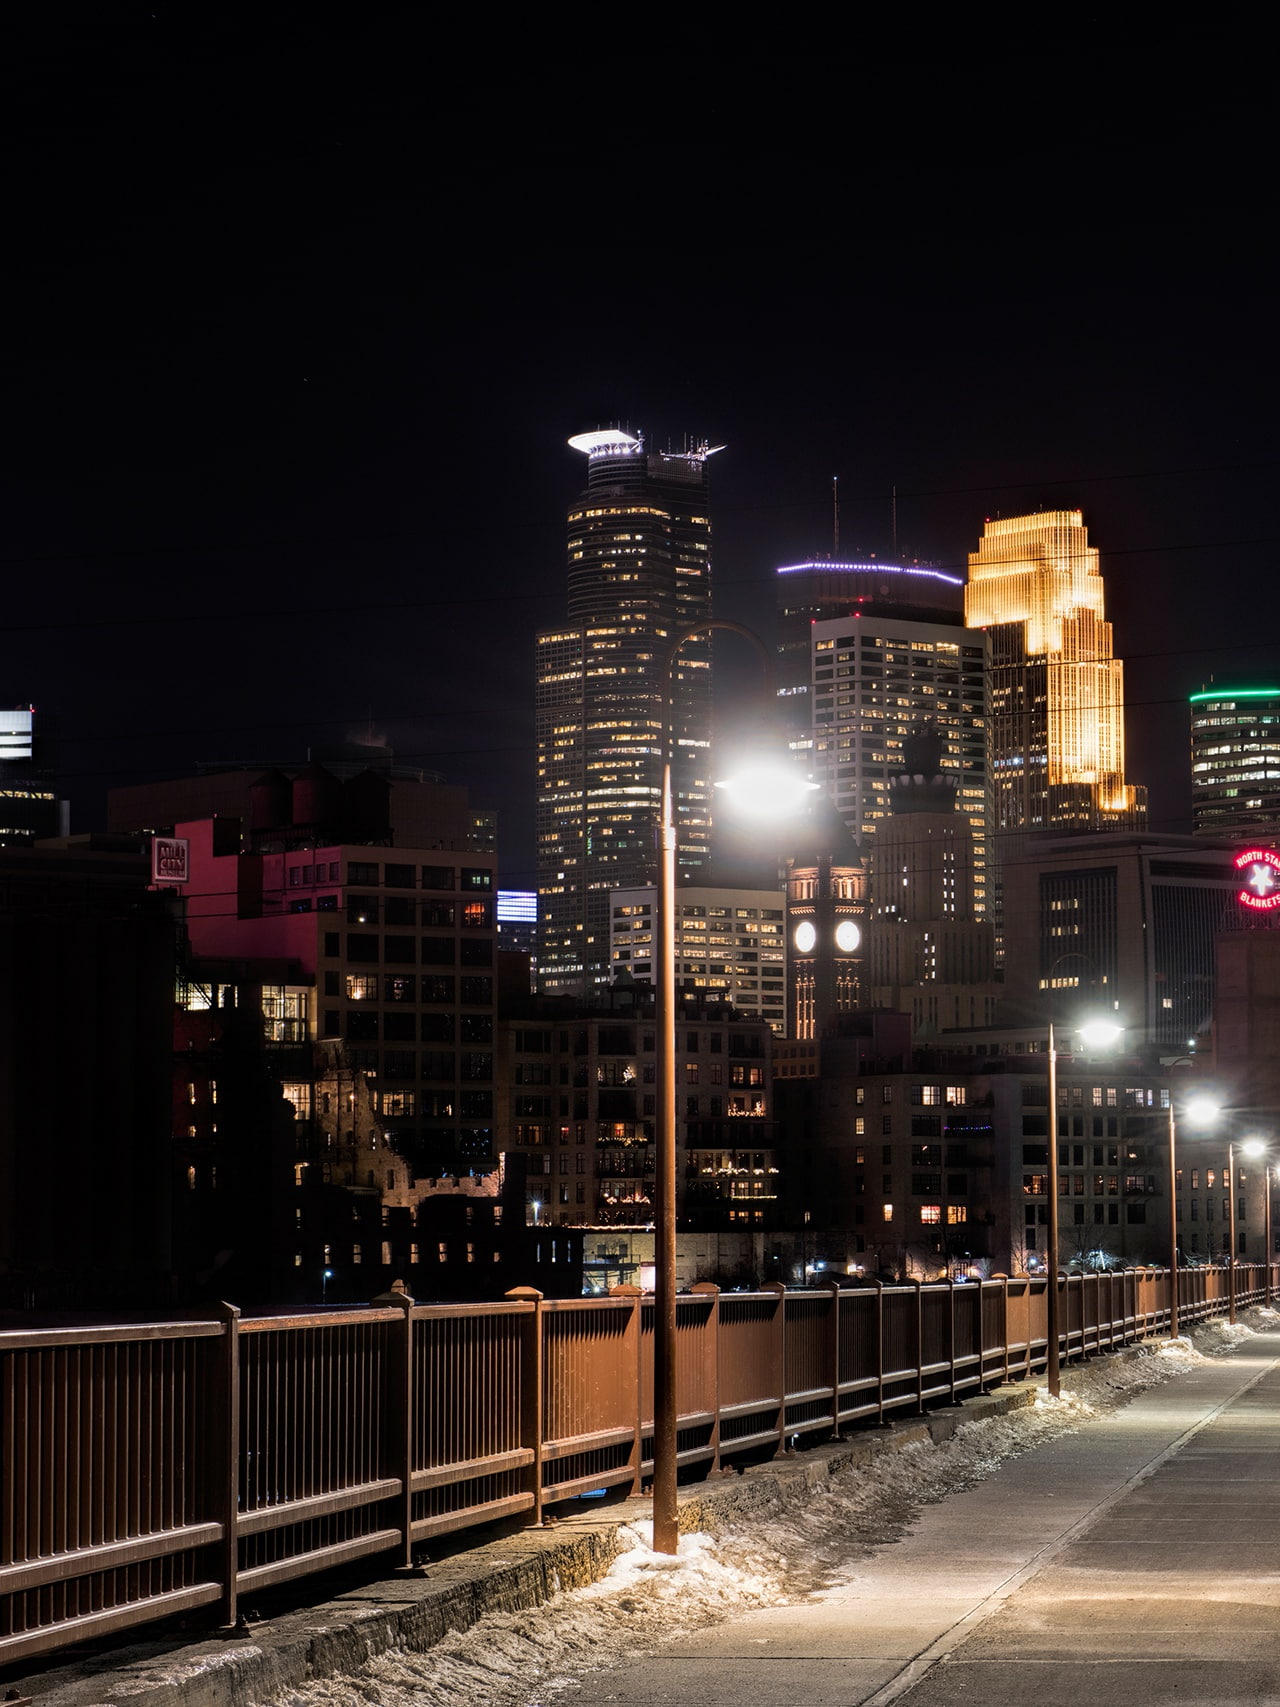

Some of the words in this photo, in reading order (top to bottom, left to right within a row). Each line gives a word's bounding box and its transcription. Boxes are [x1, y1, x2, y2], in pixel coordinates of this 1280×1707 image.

[160, 846, 185, 859] MILL
[160, 858, 185, 870] CITY
[1236, 851, 1263, 868] NORTH
